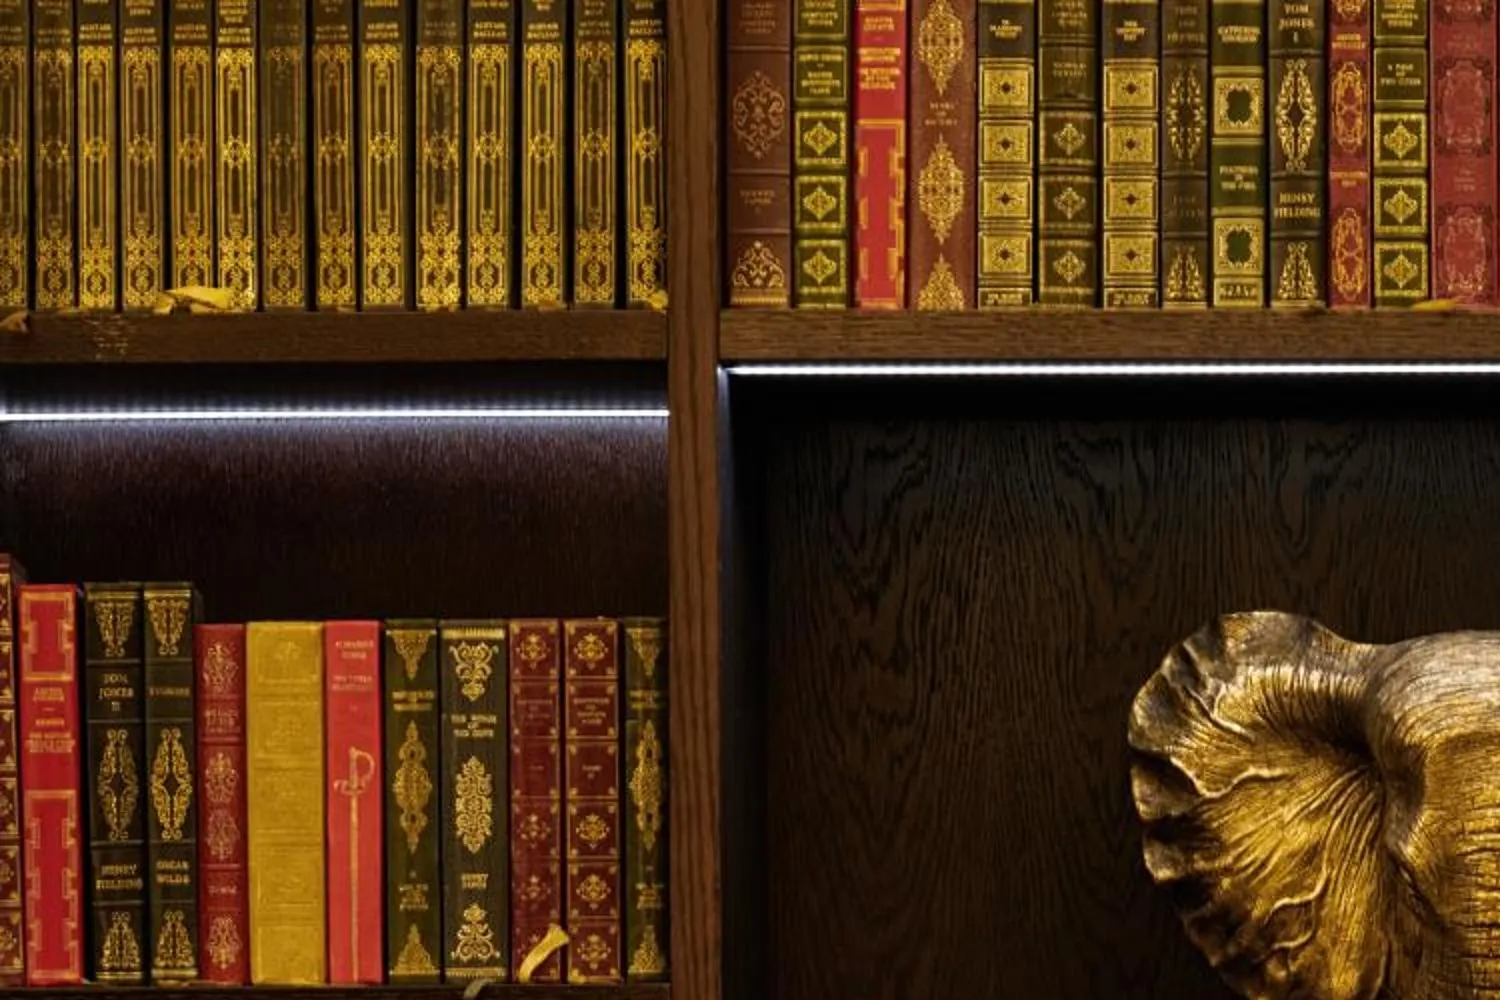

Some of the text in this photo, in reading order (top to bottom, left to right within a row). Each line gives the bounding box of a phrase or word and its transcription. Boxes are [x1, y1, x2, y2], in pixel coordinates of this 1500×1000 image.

[1285, 4, 1309, 14] TOM
[1279, 18, 1316, 30] JONES
[1279, 192, 1316, 204] HENRY
[103, 673, 129, 684] TOM
[98, 687, 135, 700] JONES
[101, 864, 138, 876] HENRY
